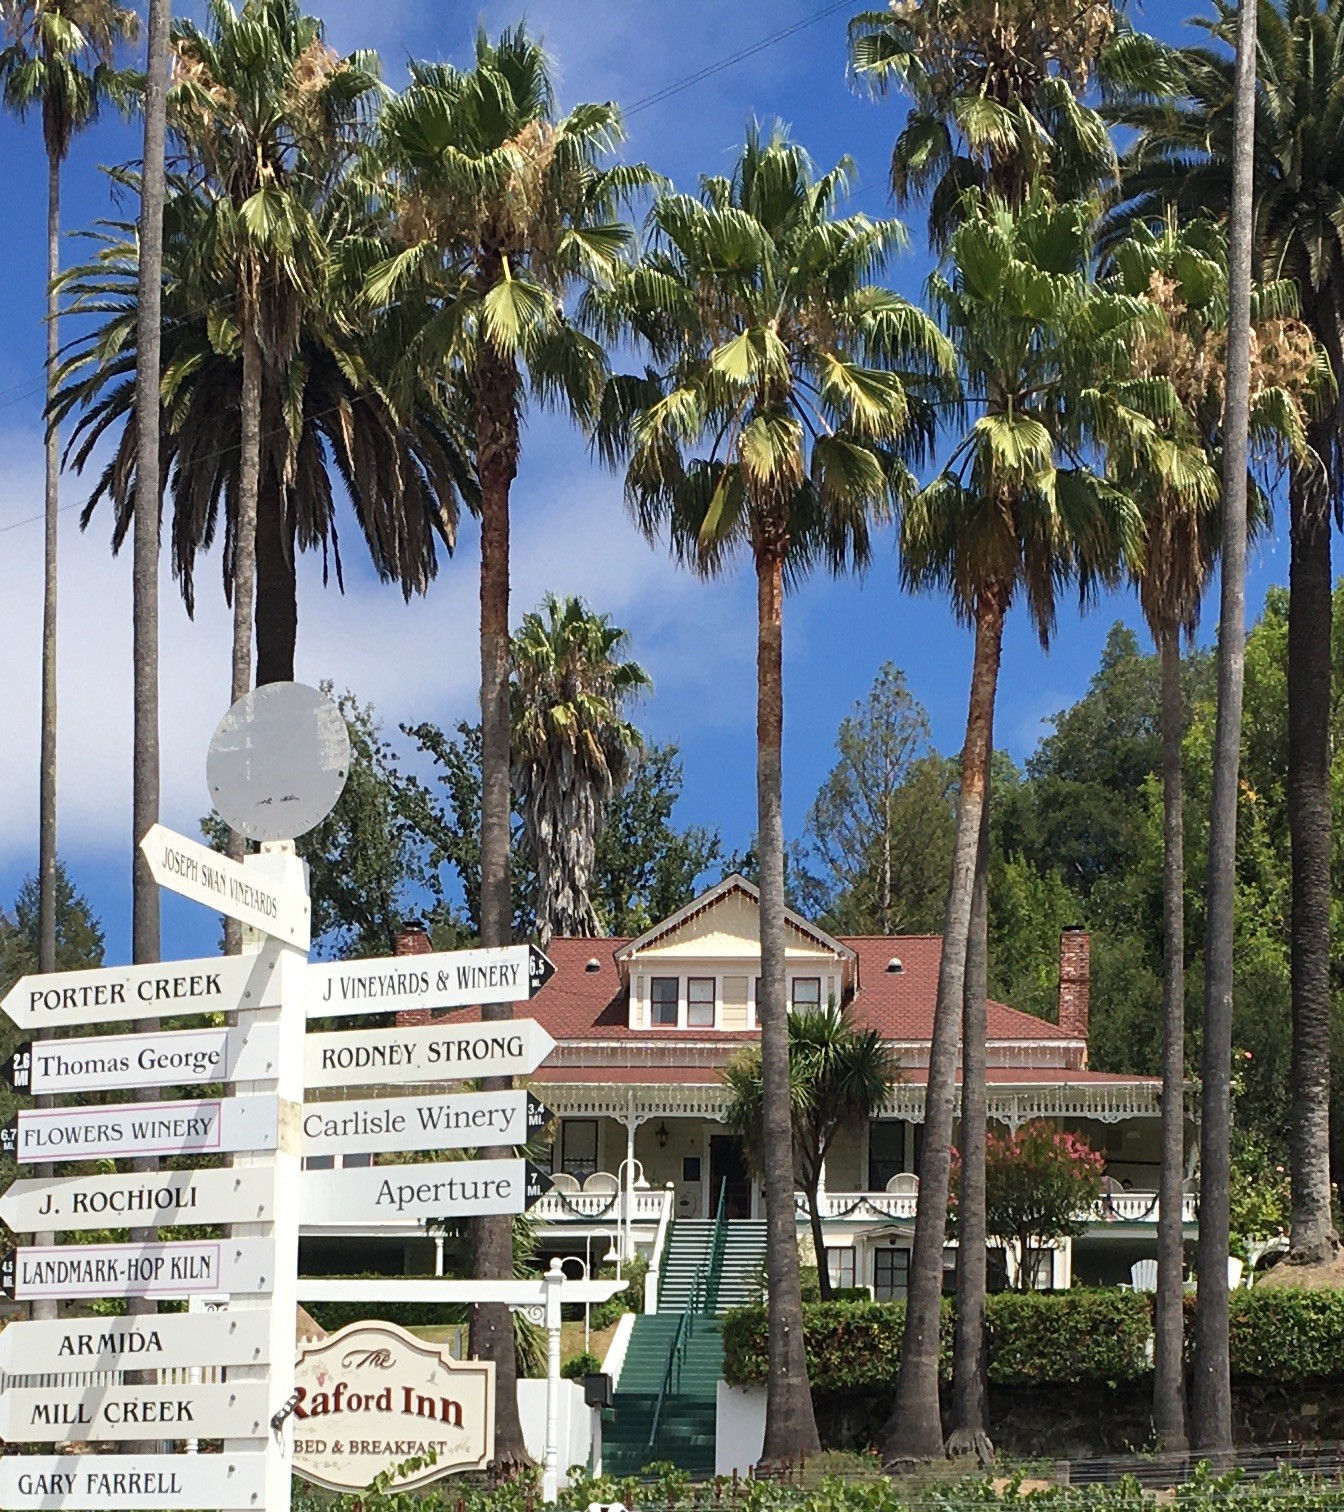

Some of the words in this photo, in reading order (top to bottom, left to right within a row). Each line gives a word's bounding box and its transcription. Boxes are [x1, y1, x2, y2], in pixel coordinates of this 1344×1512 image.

[162, 846, 198, 882] JOSEPH
[201, 864, 226, 896] SWAN
[229, 877, 277, 919] VINEYARDS
[529, 955, 545, 976] 6.5
[30, 984, 125, 1011] PORTER
[137, 974, 221, 1001] CREEK
[323, 978, 331, 1001] J
[340, 972, 429, 999] VINEYARDS
[436, 970, 449, 991] &
[457, 964, 519, 989] WINERY
[13, 1053, 30, 1070] 2.6
[38, 1056, 129, 1076] Thomas
[138, 1049, 220, 1073] George
[322, 1044, 416, 1069] RODNEY
[428, 1036, 523, 1063] STRONG
[14, 1070, 29, 1087] MI
[528, 1103, 544, 1114] 3.4
[528, 1115, 544, 1126] MI.
[25, 1124, 123, 1146] FLOWERS
[132, 1118, 212, 1139] WINERY
[304, 1110, 405, 1137] Carlisle
[417, 1106, 516, 1132] Winery
[0, 1128, 17, 1141] 6.7
[530, 1173, 537, 1184] 7
[39, 1195, 59, 1215] J.
[73, 1187, 196, 1213] ROCHIOLI
[375, 1178, 511, 1211] Aperture
[23, 1258, 164, 1284] LANDMARK-HOP
[170, 1256, 210, 1279] KILN
[58, 1331, 162, 1356] ARMIDA
[342, 1348, 396, 1369] The
[30, 1404, 92, 1424] MILL
[104, 1401, 193, 1423] CREEK
[402, 1386, 464, 1430] Inn
[294, 1439, 327, 1454] BED
[332, 1439, 344, 1455] &
[349, 1440, 448, 1455] BREAKFAST
[18, 1474, 77, 1495] GARY
[87, 1473, 182, 1496] FARRELL
